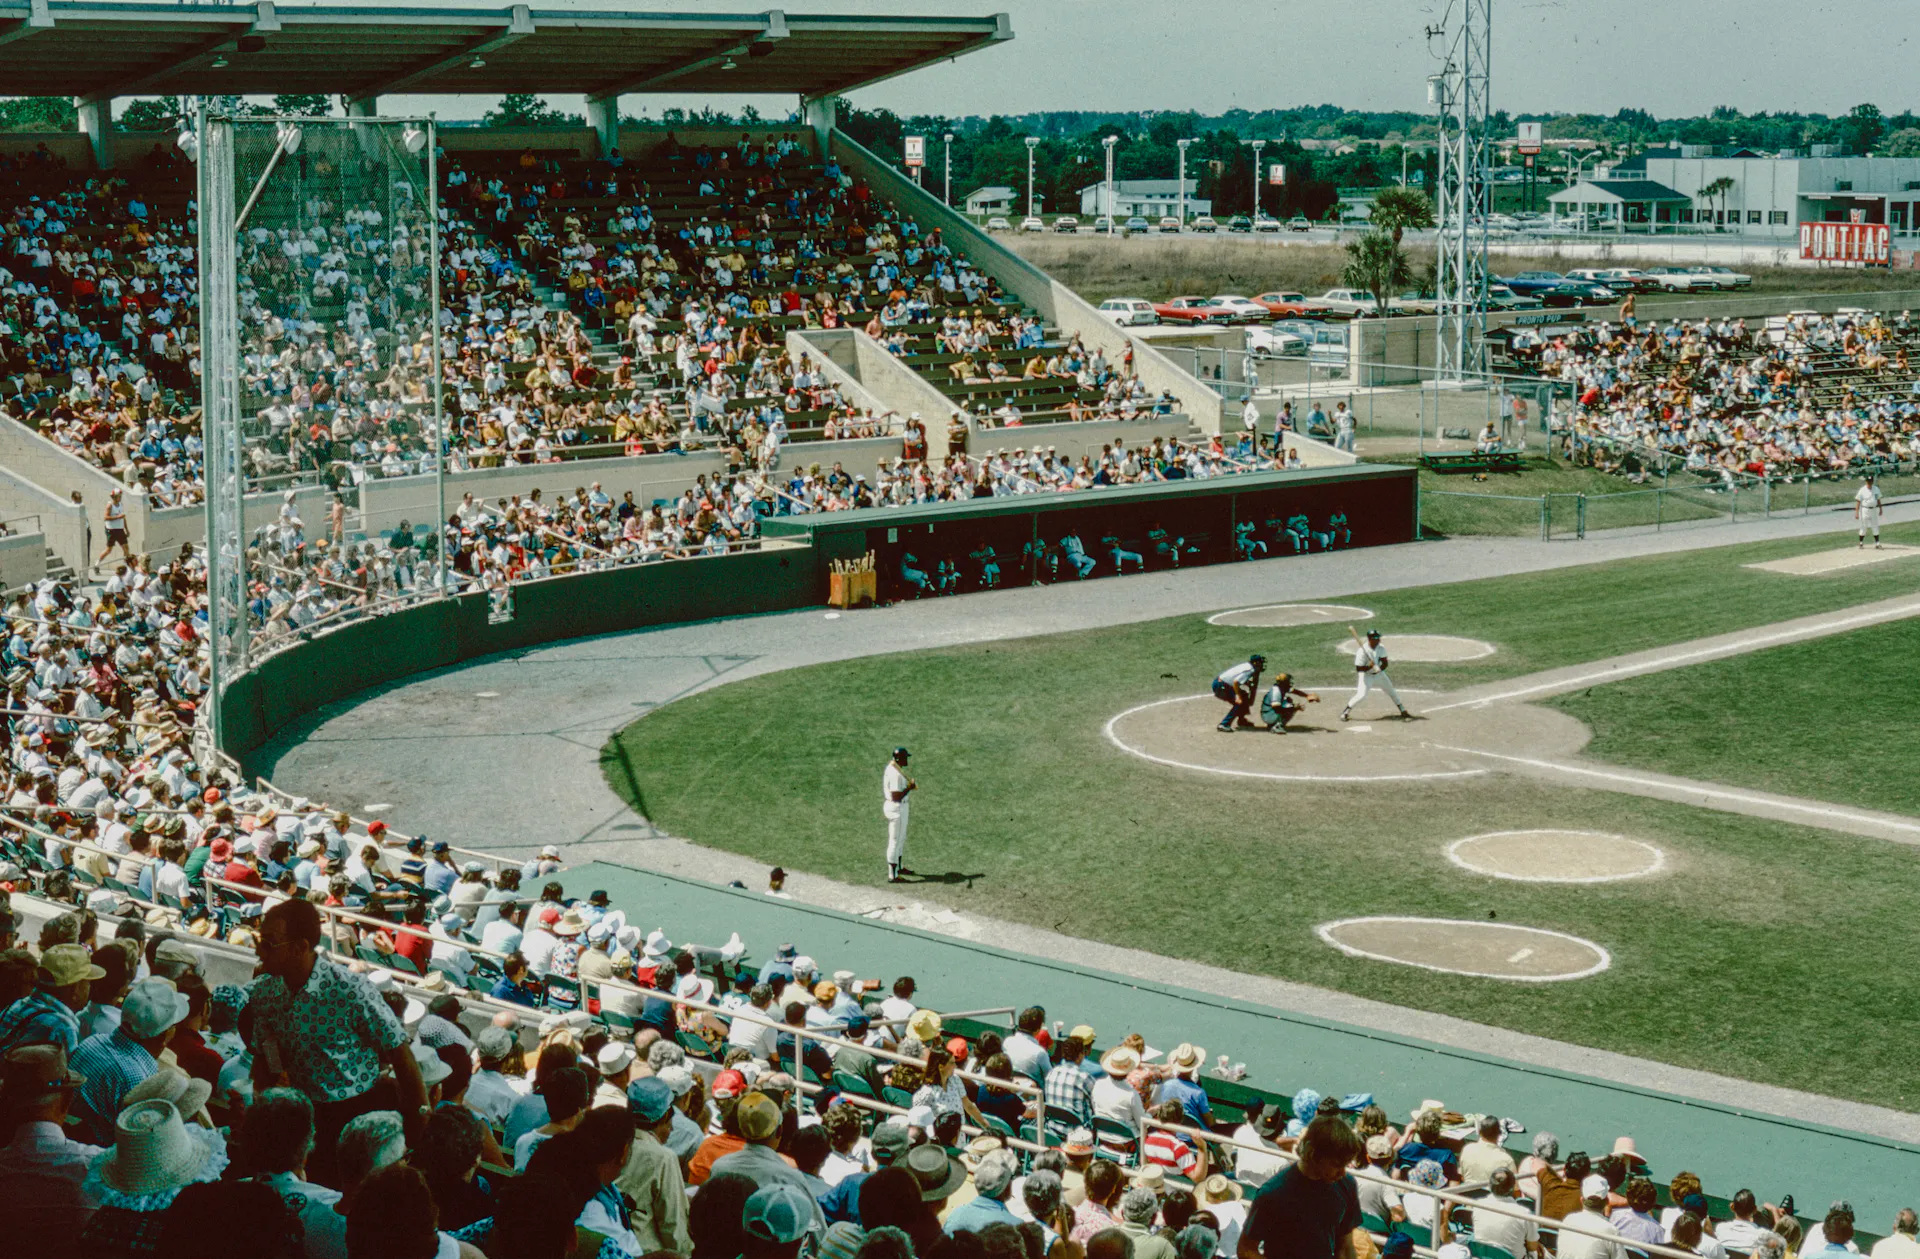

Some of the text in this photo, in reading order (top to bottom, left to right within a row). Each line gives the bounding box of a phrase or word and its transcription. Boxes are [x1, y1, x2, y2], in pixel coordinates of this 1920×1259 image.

[1801, 225, 1888, 260] PONTIAC
[1518, 314, 1562, 325] PRONTO PUP
